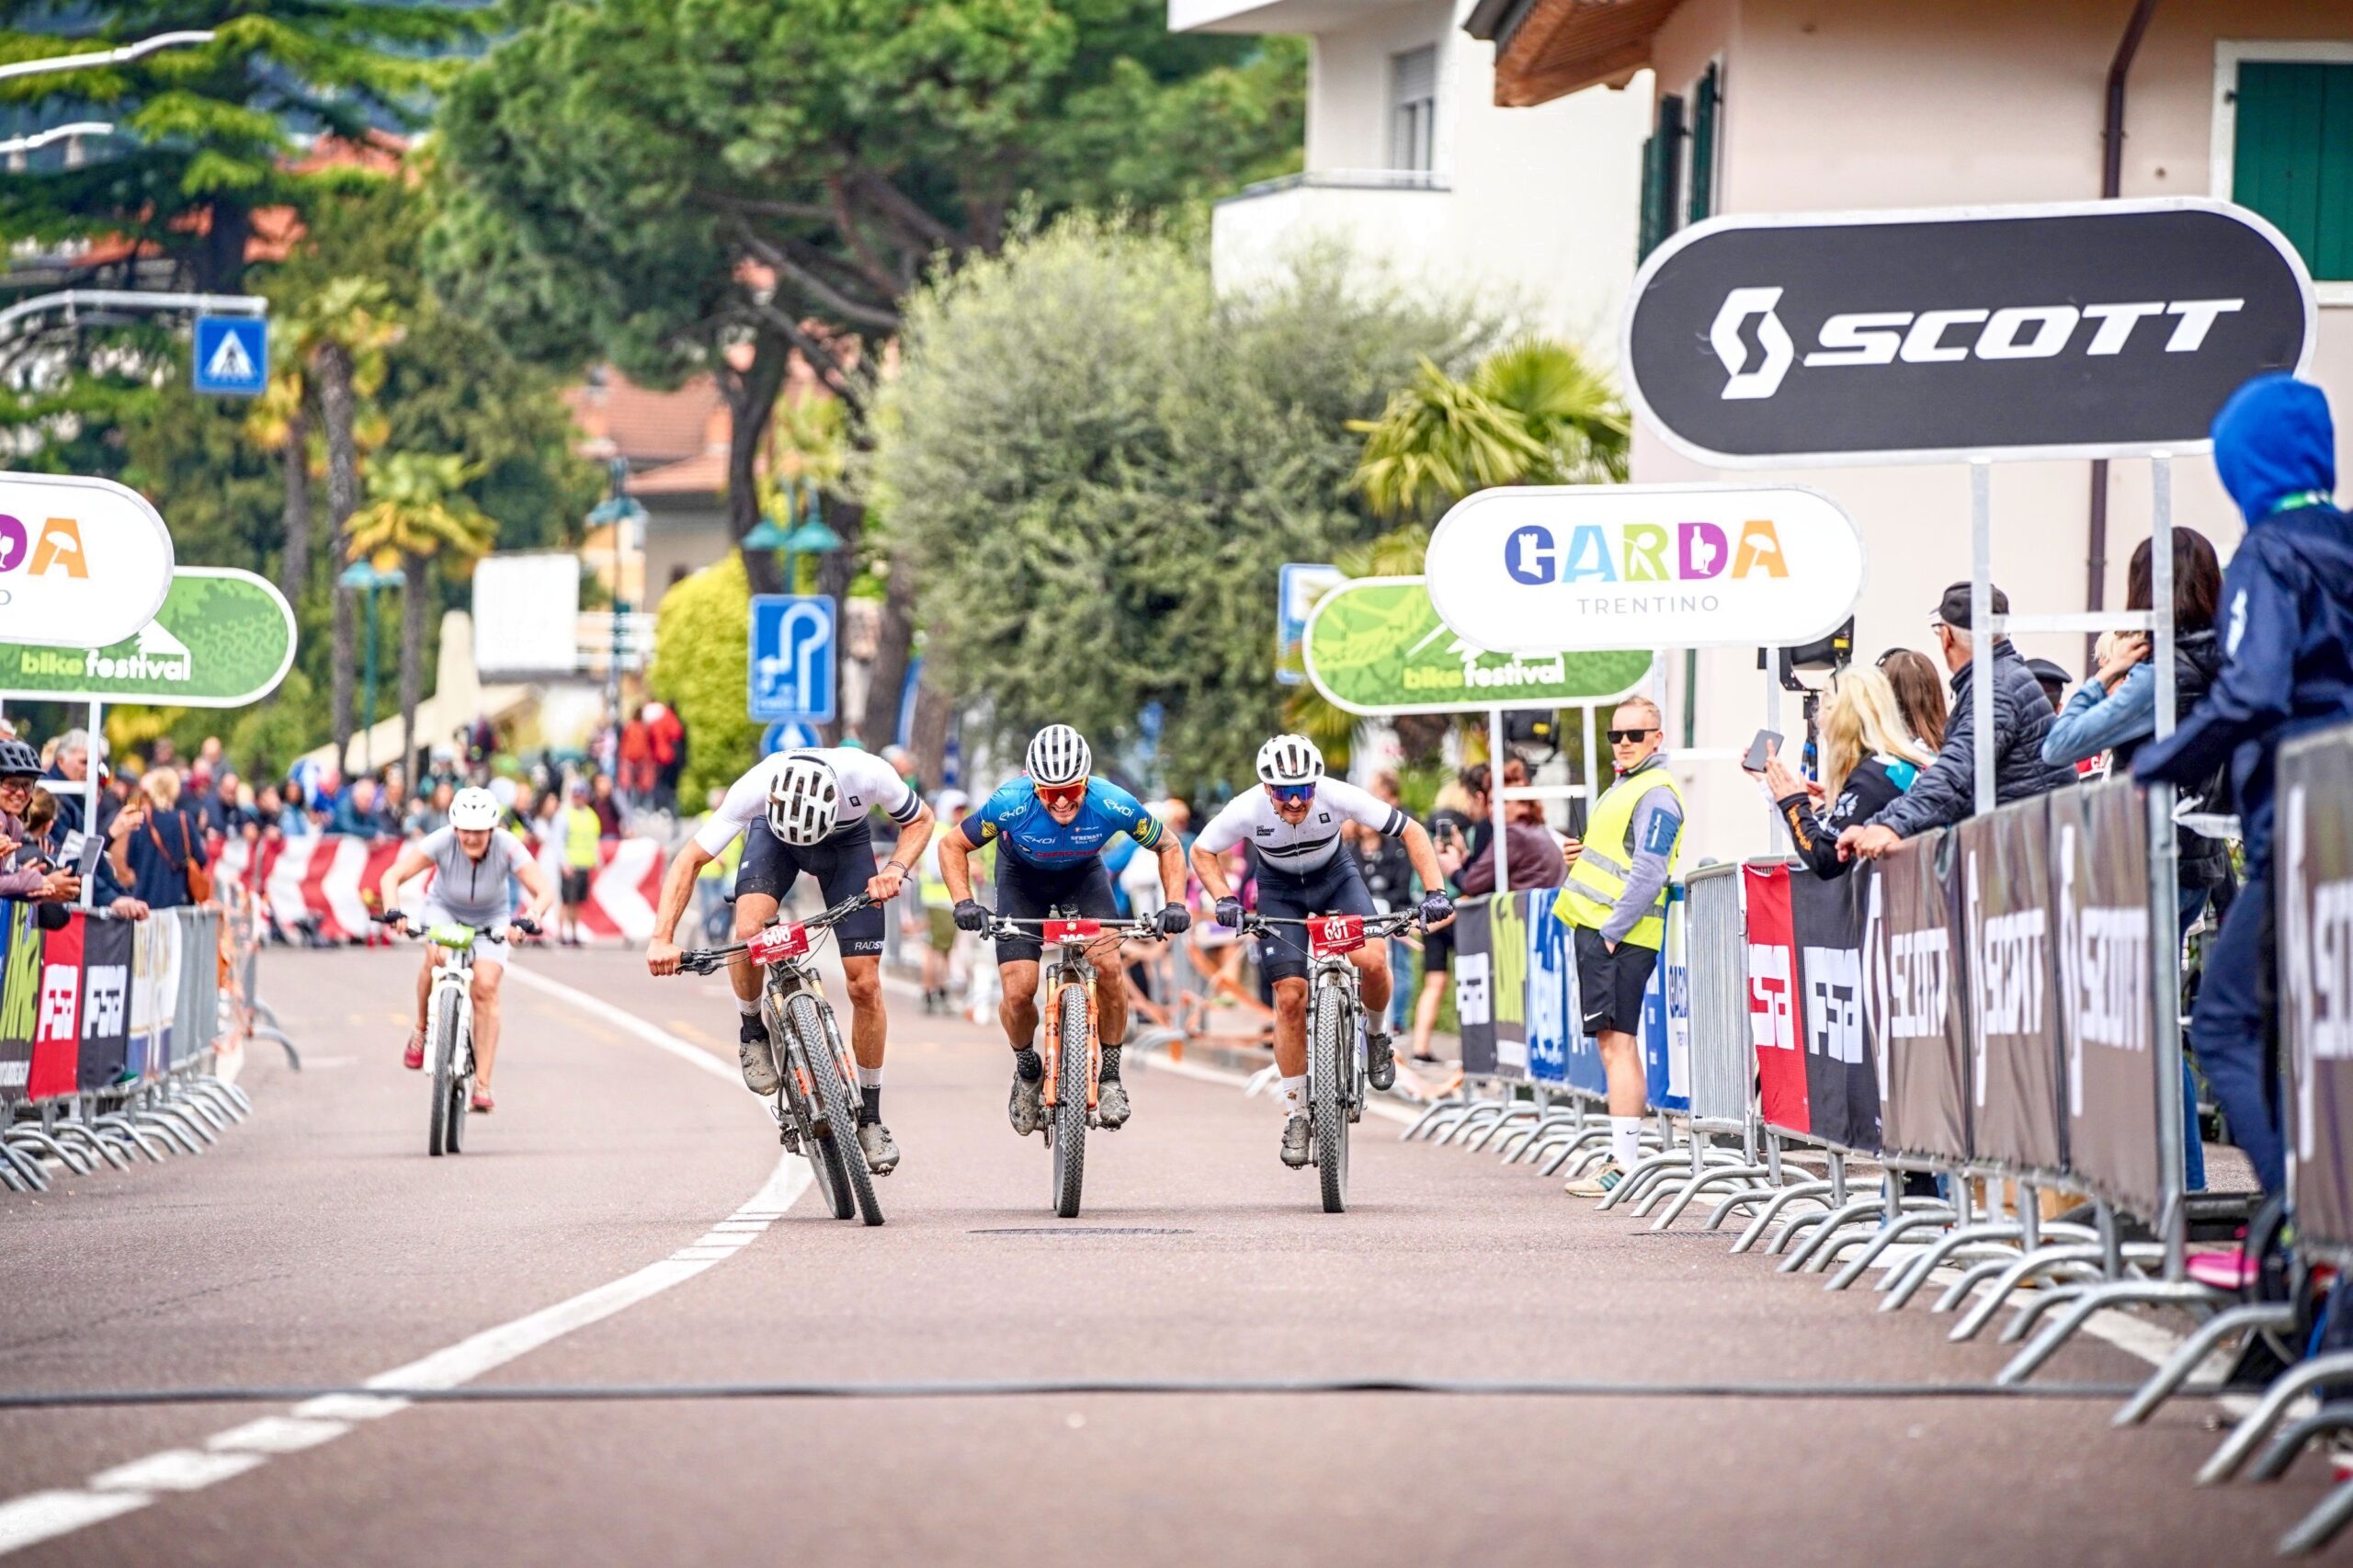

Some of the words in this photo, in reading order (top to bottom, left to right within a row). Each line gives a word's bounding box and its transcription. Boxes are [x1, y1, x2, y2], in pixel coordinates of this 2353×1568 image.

[1803, 299, 2245, 367] SCOTT
[1505, 520, 1790, 585] GARDA
[1577, 595, 1719, 614] TRENTINO
[762, 925, 791, 948] 608
[1324, 920, 1349, 941] 601
[1891, 926, 1949, 1038] SCOTT
[1985, 908, 2045, 1035] SCOTT
[2081, 906, 2148, 1052] SCOTT
